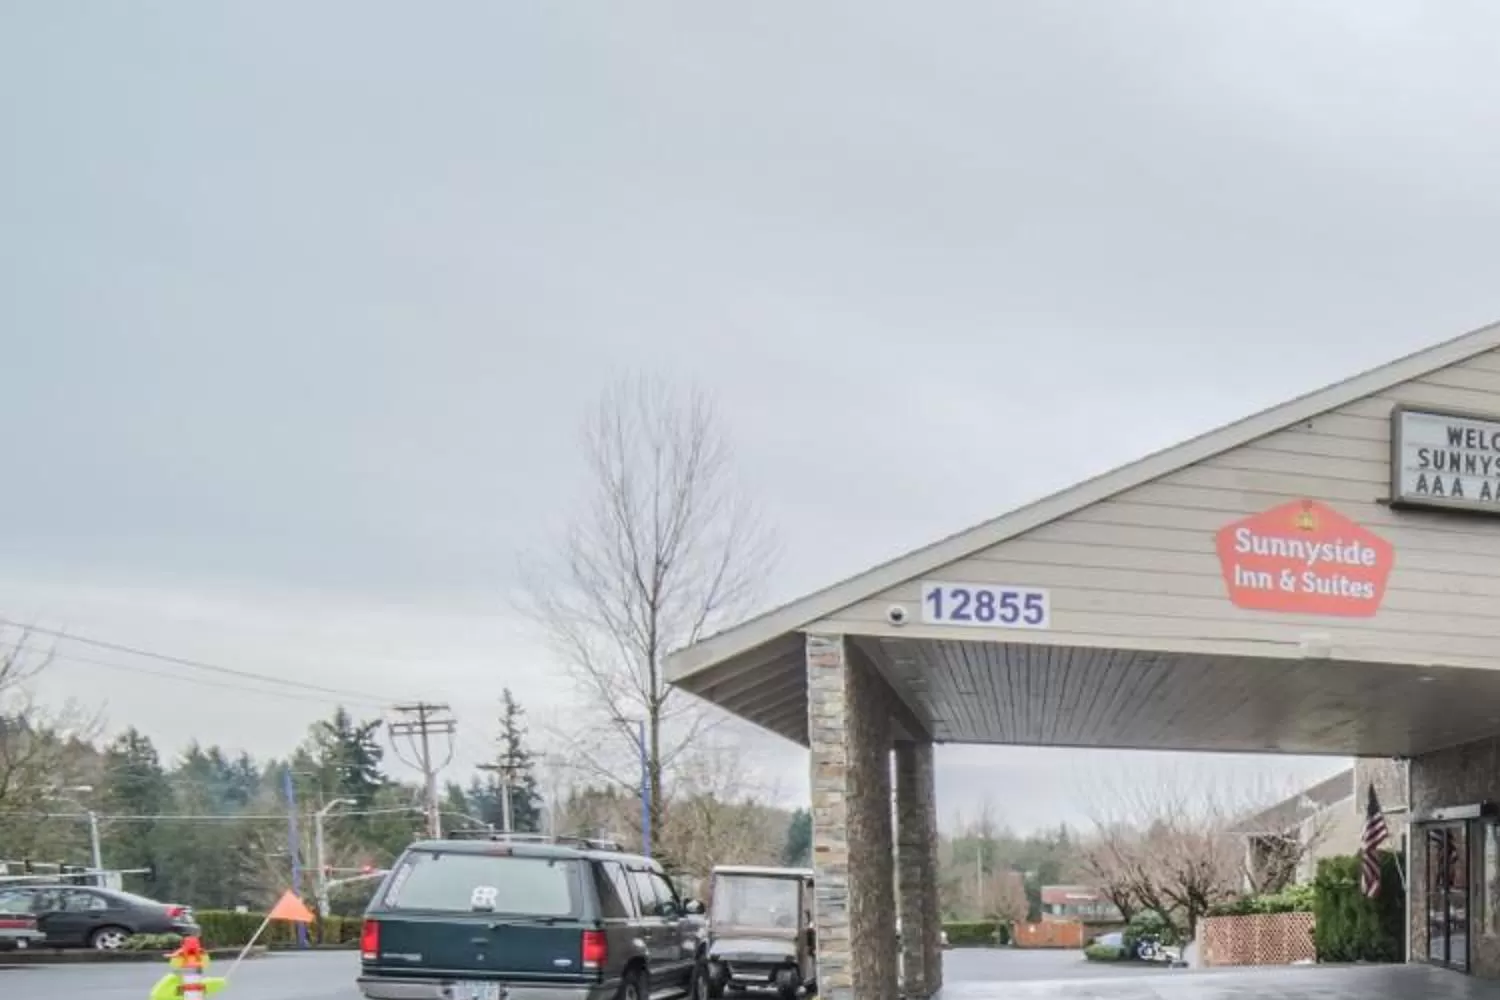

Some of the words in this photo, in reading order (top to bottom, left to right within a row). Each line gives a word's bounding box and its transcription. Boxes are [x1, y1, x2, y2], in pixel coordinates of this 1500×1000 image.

[1416, 474, 1464, 497] AAA
[1235, 527, 1377, 566] Sunnyside
[1235, 564, 1273, 590] Inn
[1279, 568, 1296, 592] &
[1303, 571, 1375, 599] Suites
[926, 587, 1044, 625] 12855
